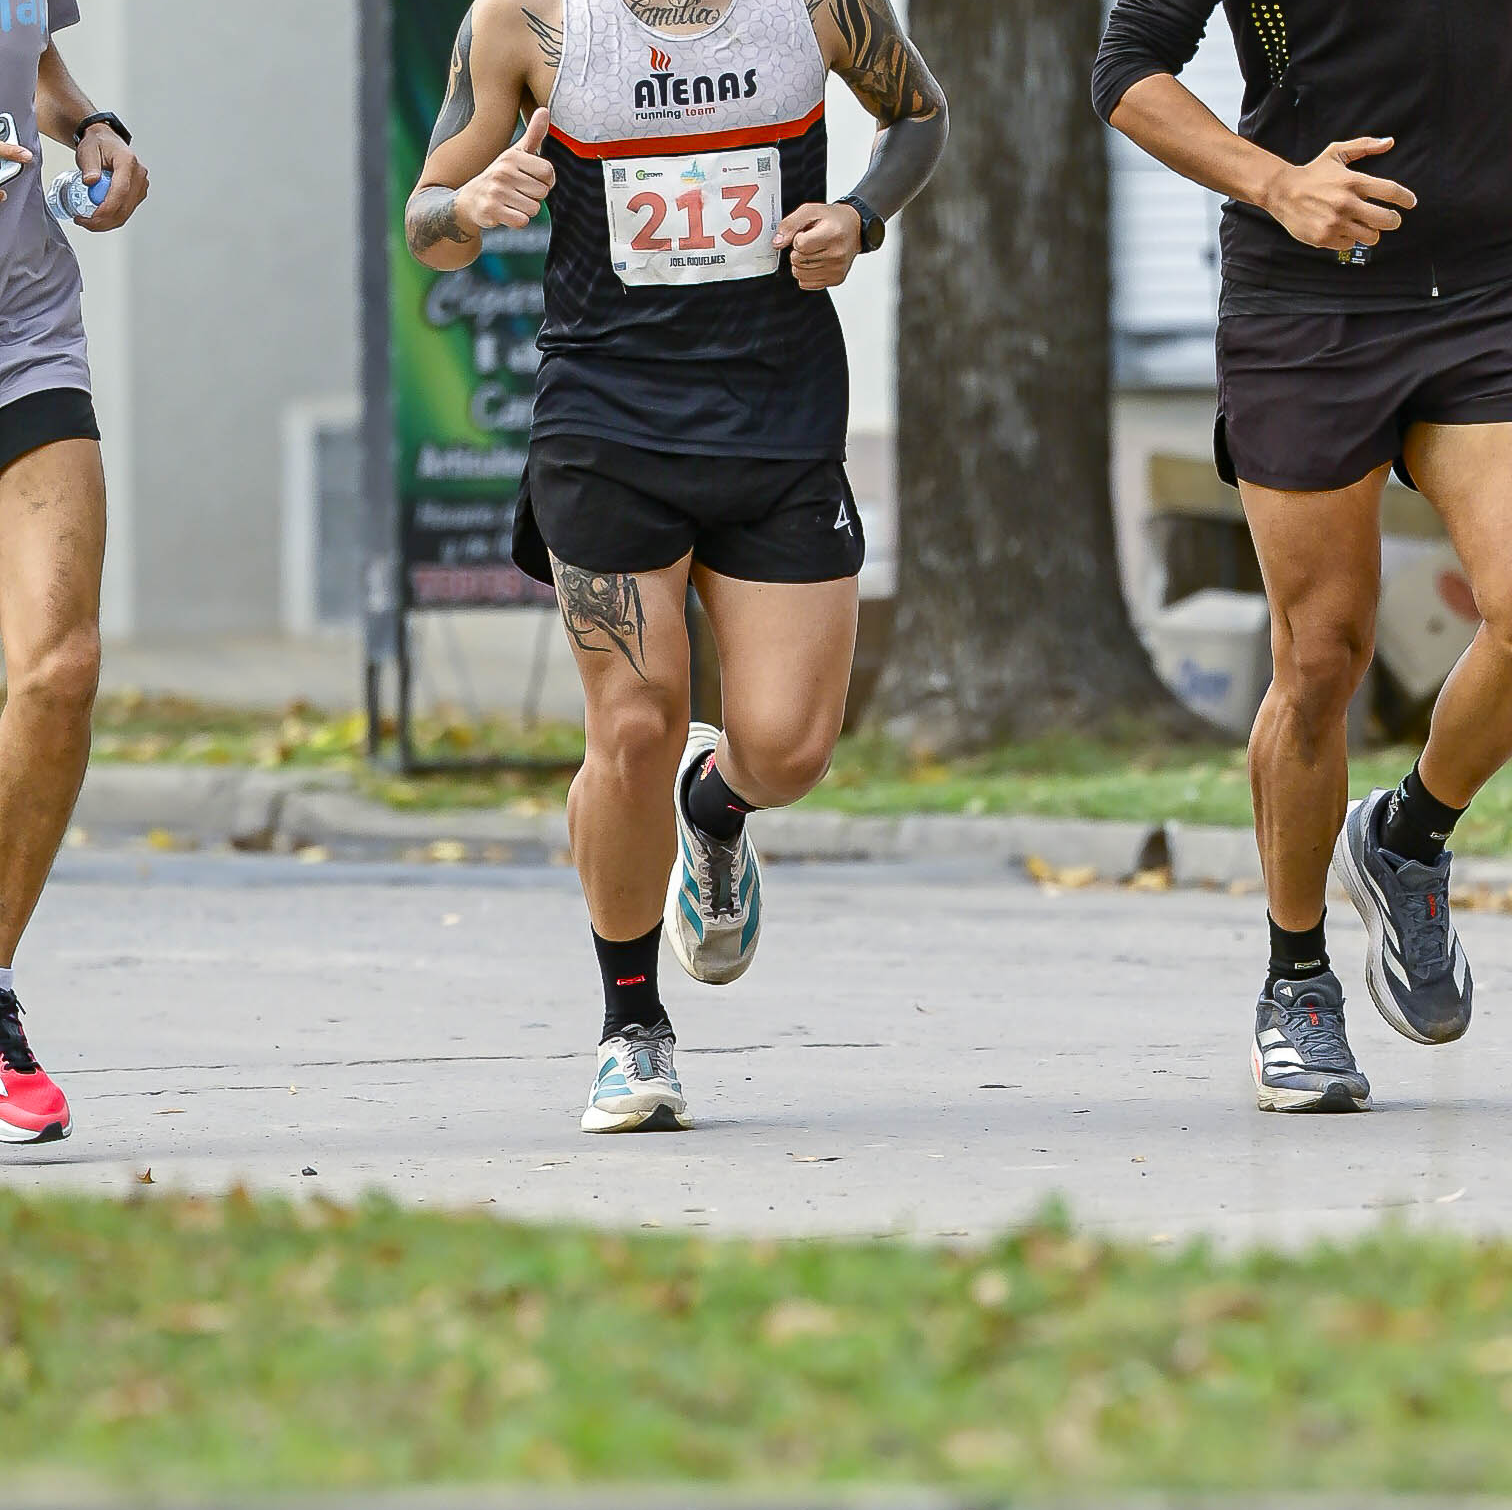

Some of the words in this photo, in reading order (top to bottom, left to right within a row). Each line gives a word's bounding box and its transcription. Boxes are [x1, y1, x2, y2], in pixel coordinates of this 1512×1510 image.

[634, 68, 757, 108] ATENAS
[635, 108, 681, 121] running
[685, 106, 716, 117] team
[626, 183, 763, 251] 213
[669, 257, 686, 267] JOEL
